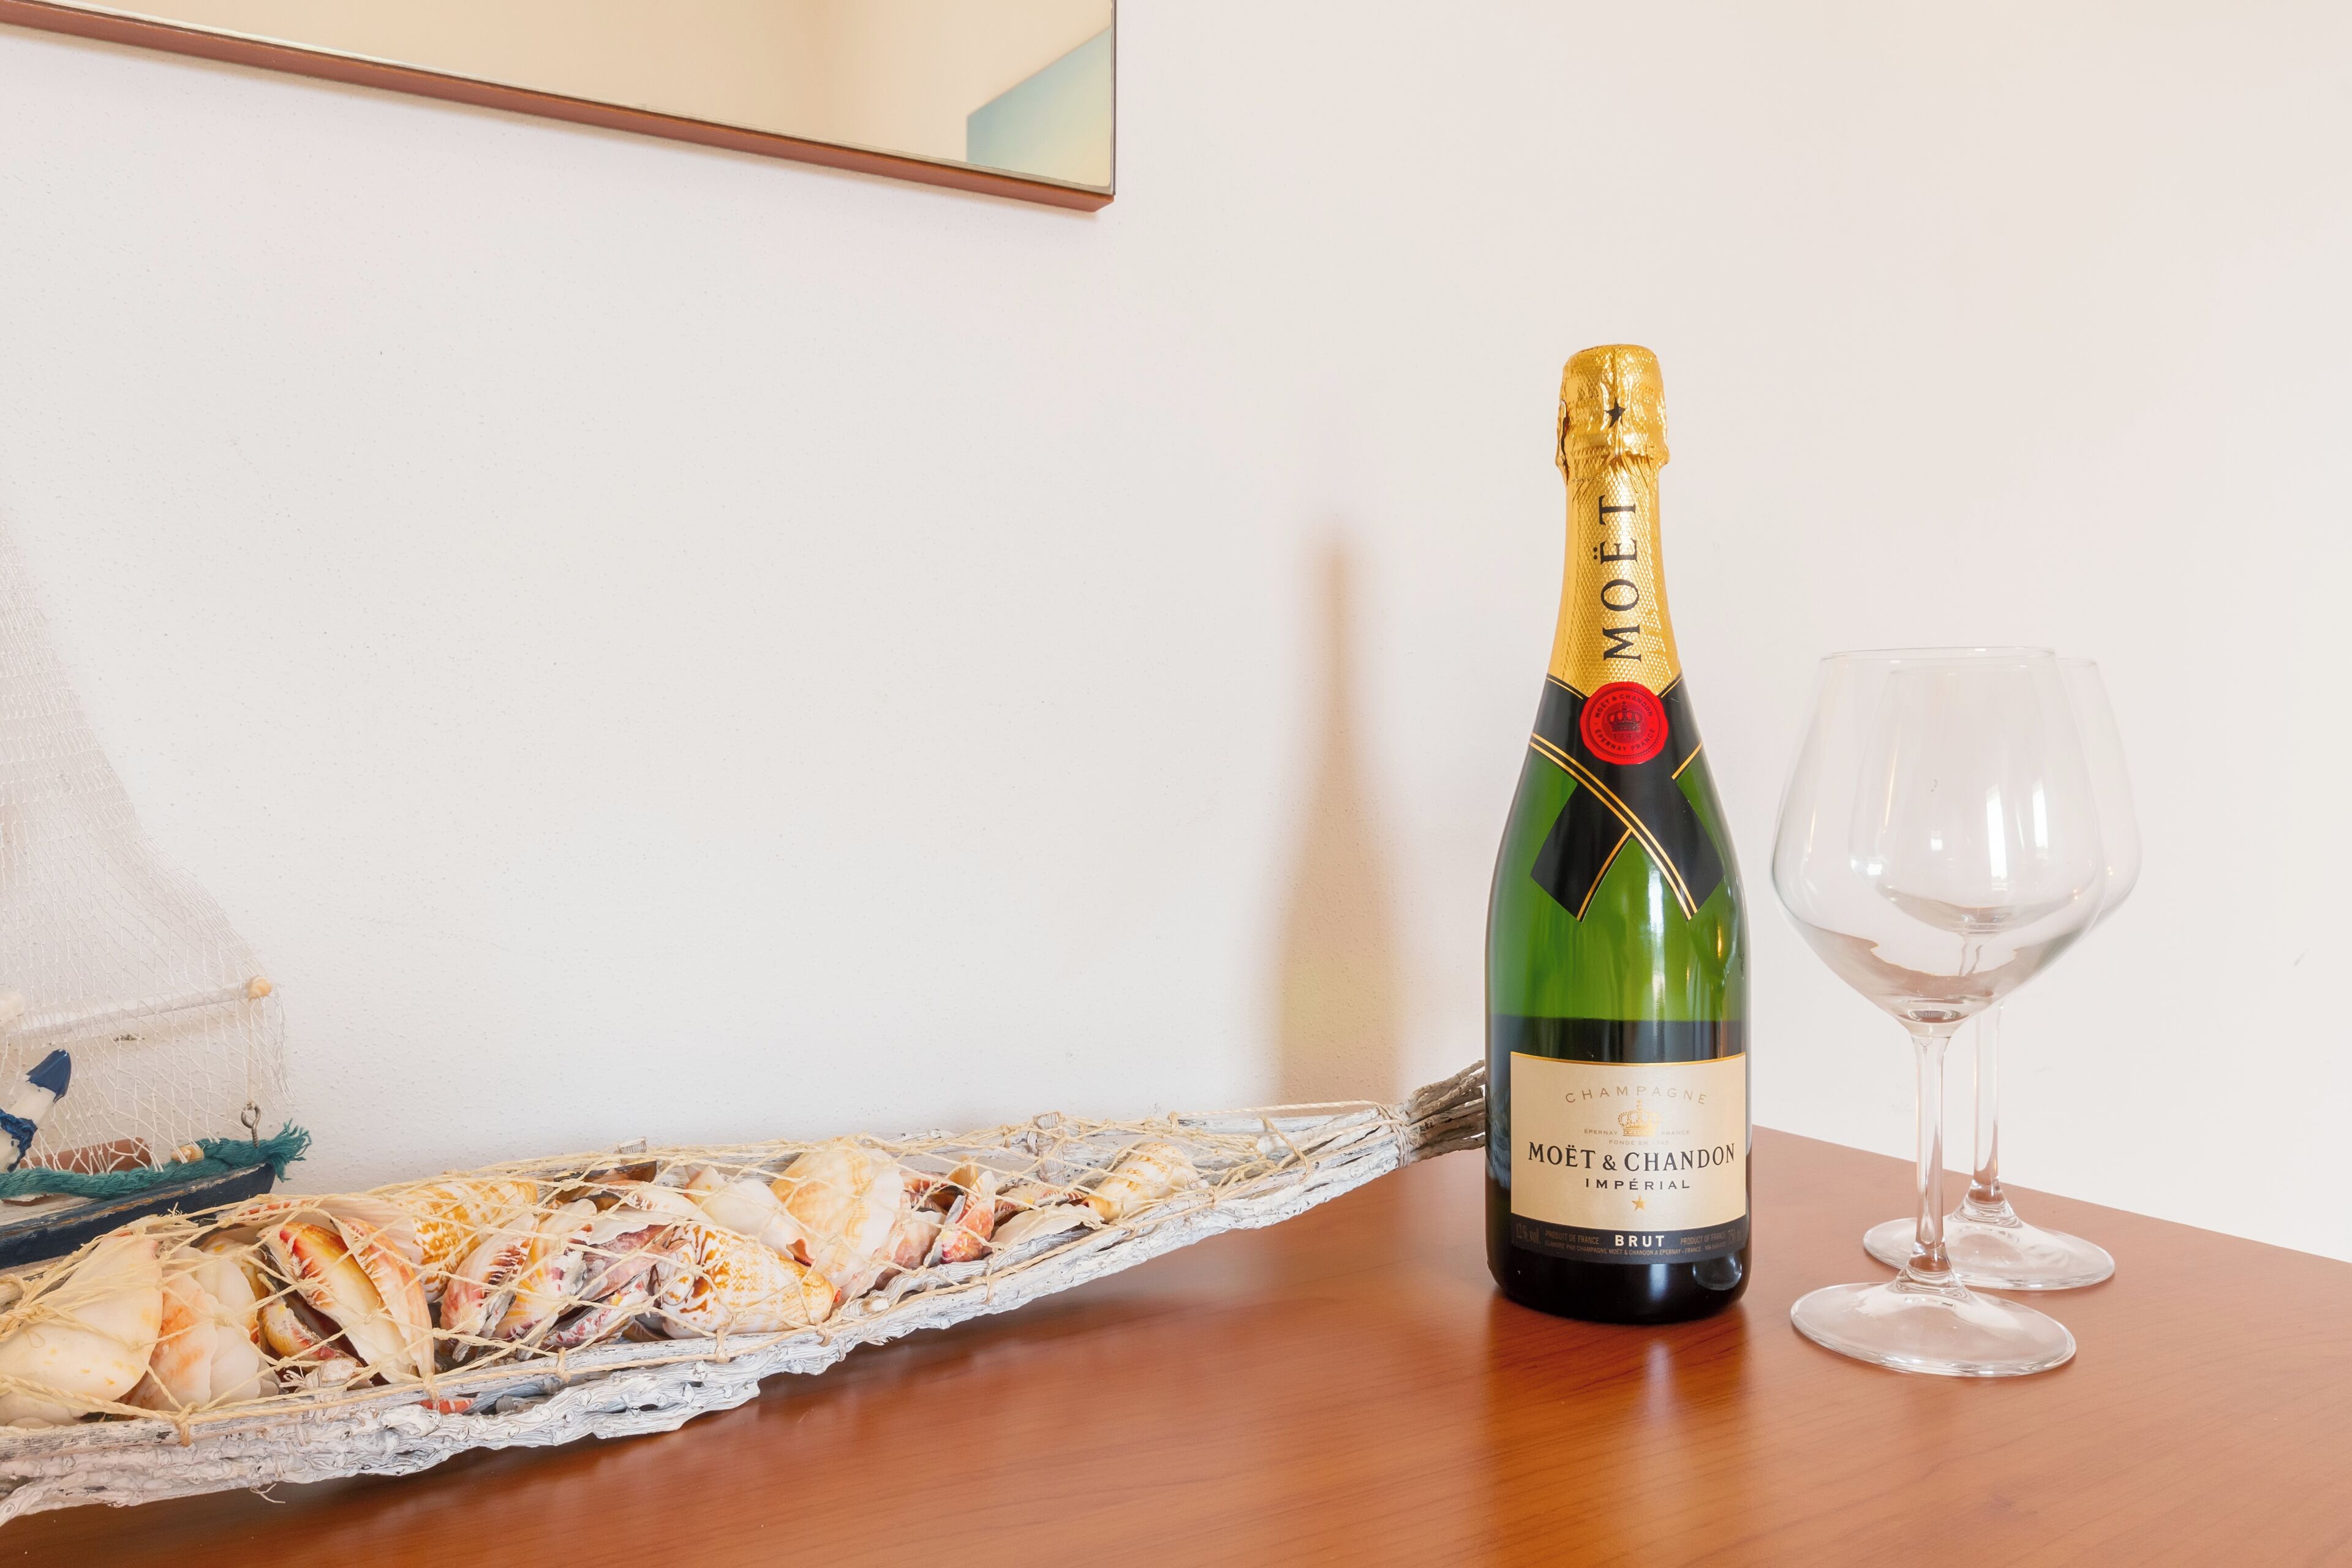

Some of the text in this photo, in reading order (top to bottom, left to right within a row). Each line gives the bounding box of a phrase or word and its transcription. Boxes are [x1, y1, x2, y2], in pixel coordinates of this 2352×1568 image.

[1593, 494, 1642, 662] MOËT
[1619, 694, 1653, 717] CHANDON
[1630, 728, 1655, 751] FRANCE
[1565, 1086, 1706, 1105] CHAMPAGNE
[1528, 1142, 1735, 1172] MOËT & CHANDON
[1585, 1178, 1691, 1190] IMPÉRIAL
[1569, 1234, 1577, 1242] DE
[1577, 1235, 1600, 1245] FRANCE
[1615, 1234, 1665, 1248] BRUT
[1680, 1235, 1703, 1245] PRODUCT
[1577, 1245, 1608, 1254] CHAMPAGNE
